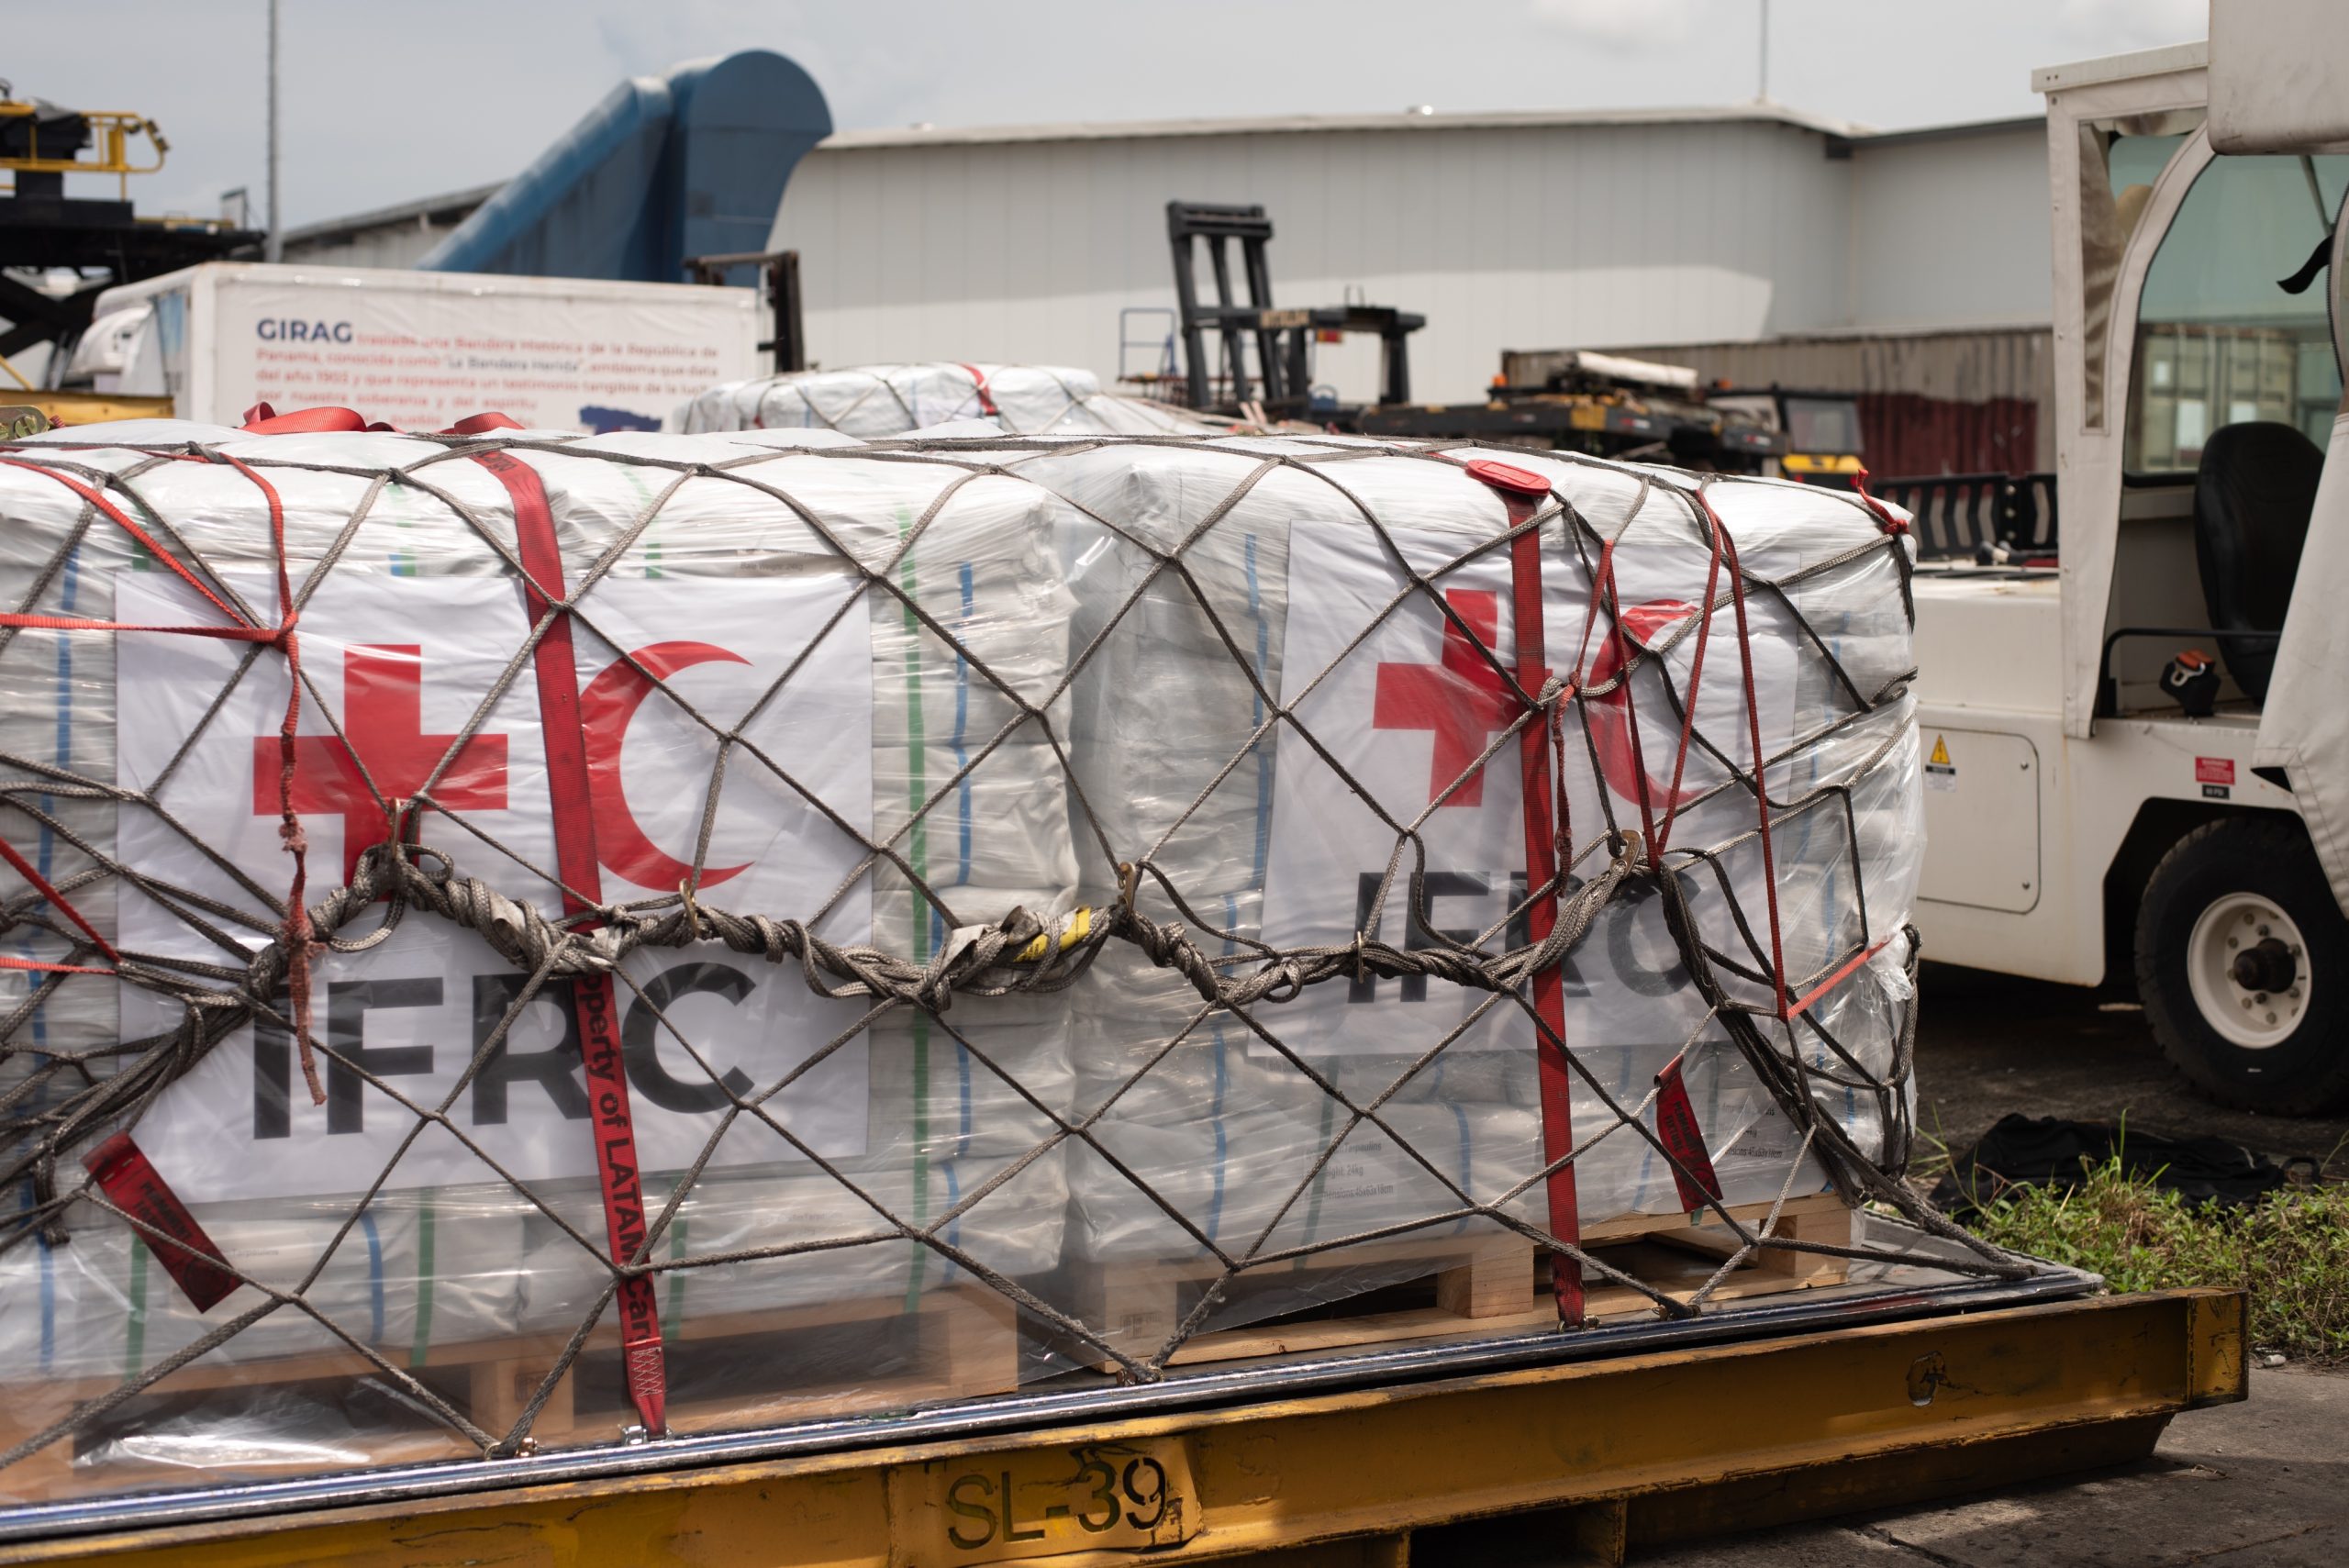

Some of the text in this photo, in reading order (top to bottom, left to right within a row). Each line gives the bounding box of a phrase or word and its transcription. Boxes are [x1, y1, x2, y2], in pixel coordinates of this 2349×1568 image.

[257, 318, 353, 343] GIRAG
[587, 342, 605, 354] de
[700, 347, 719, 358] de
[468, 356, 528, 371] Bandera
[364, 375, 392, 387] que
[254, 962, 756, 1140] IFRC
[579, 973, 658, 1342] operty of LATAM Car
[948, 1457, 1165, 1550] SL-39
